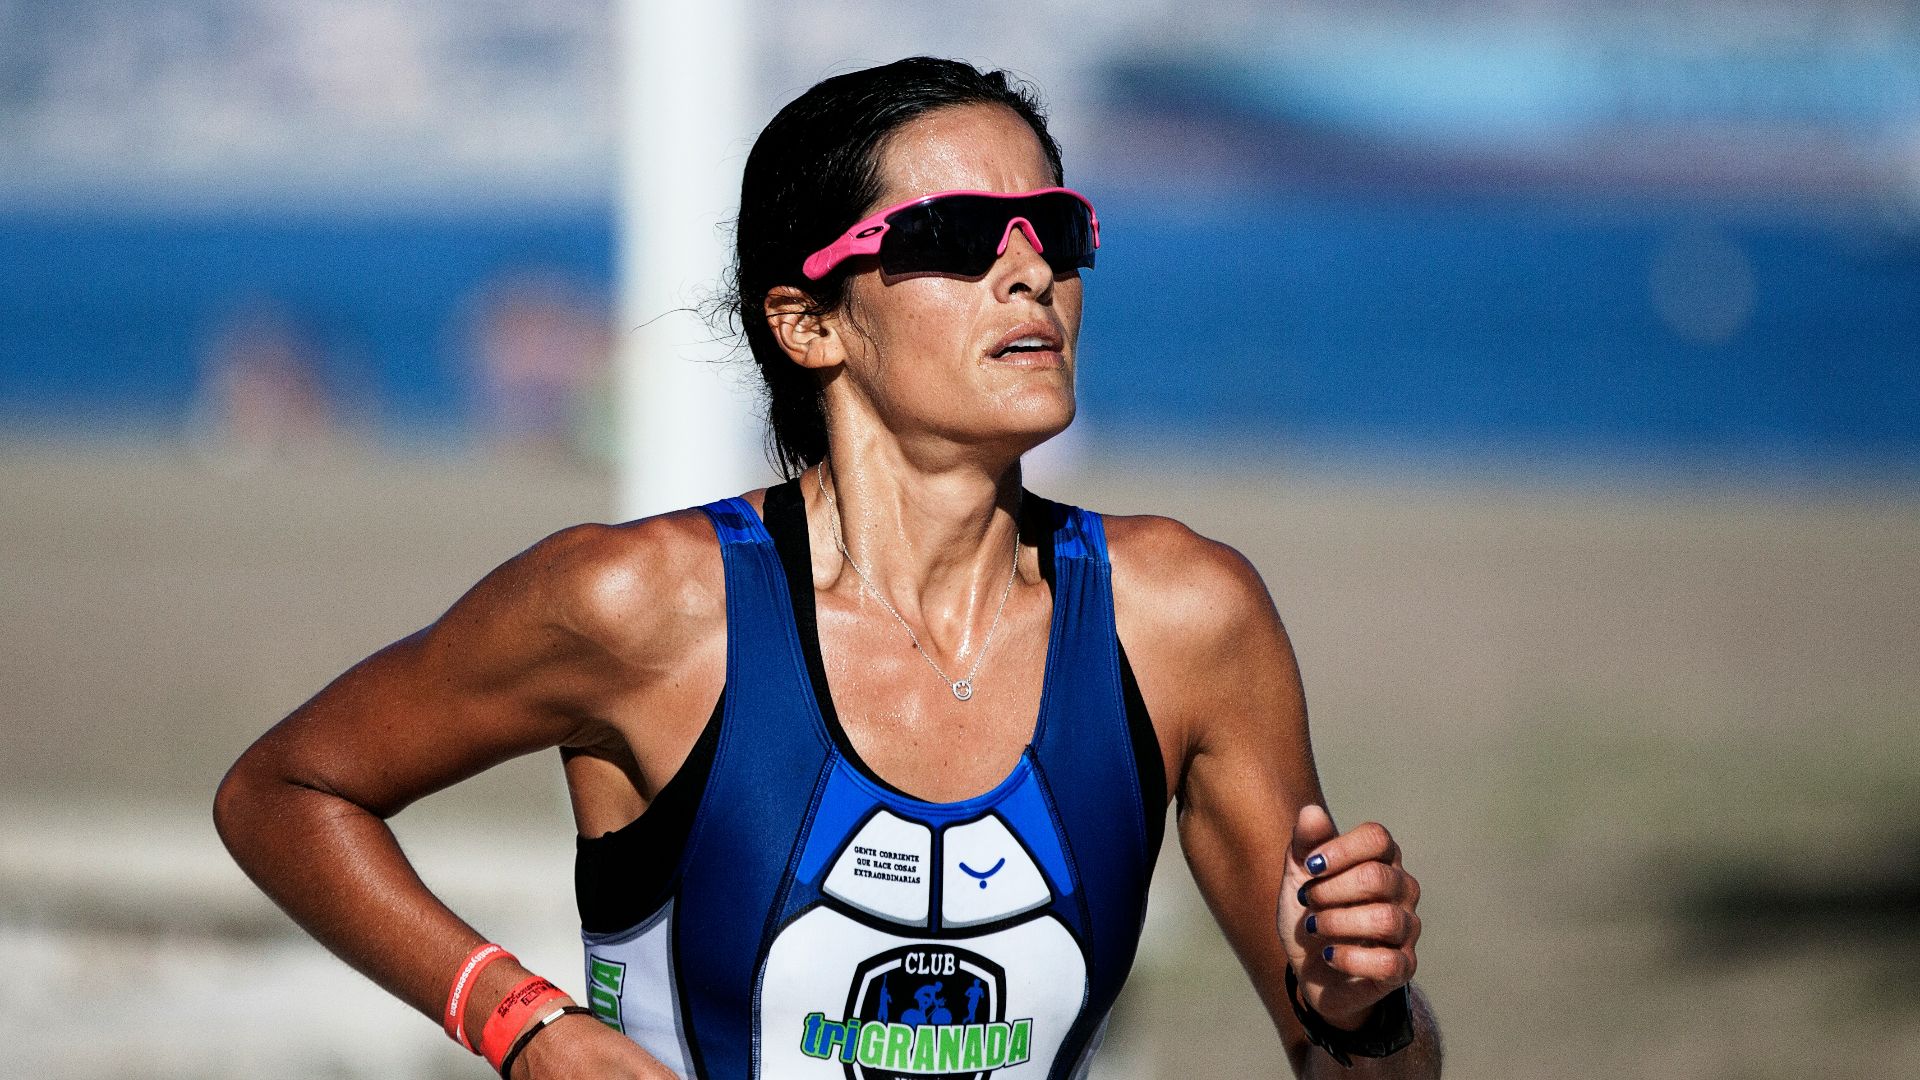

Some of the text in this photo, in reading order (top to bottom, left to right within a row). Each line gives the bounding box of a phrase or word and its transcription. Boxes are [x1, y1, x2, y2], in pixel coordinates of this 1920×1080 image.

[854, 846, 920, 863] GENTE CORRIENTE
[856, 857, 917, 873] QUE HACE COSAS
[854, 868, 921, 885] EXTRAORDINARIAS
[904, 952, 956, 976] CLUB
